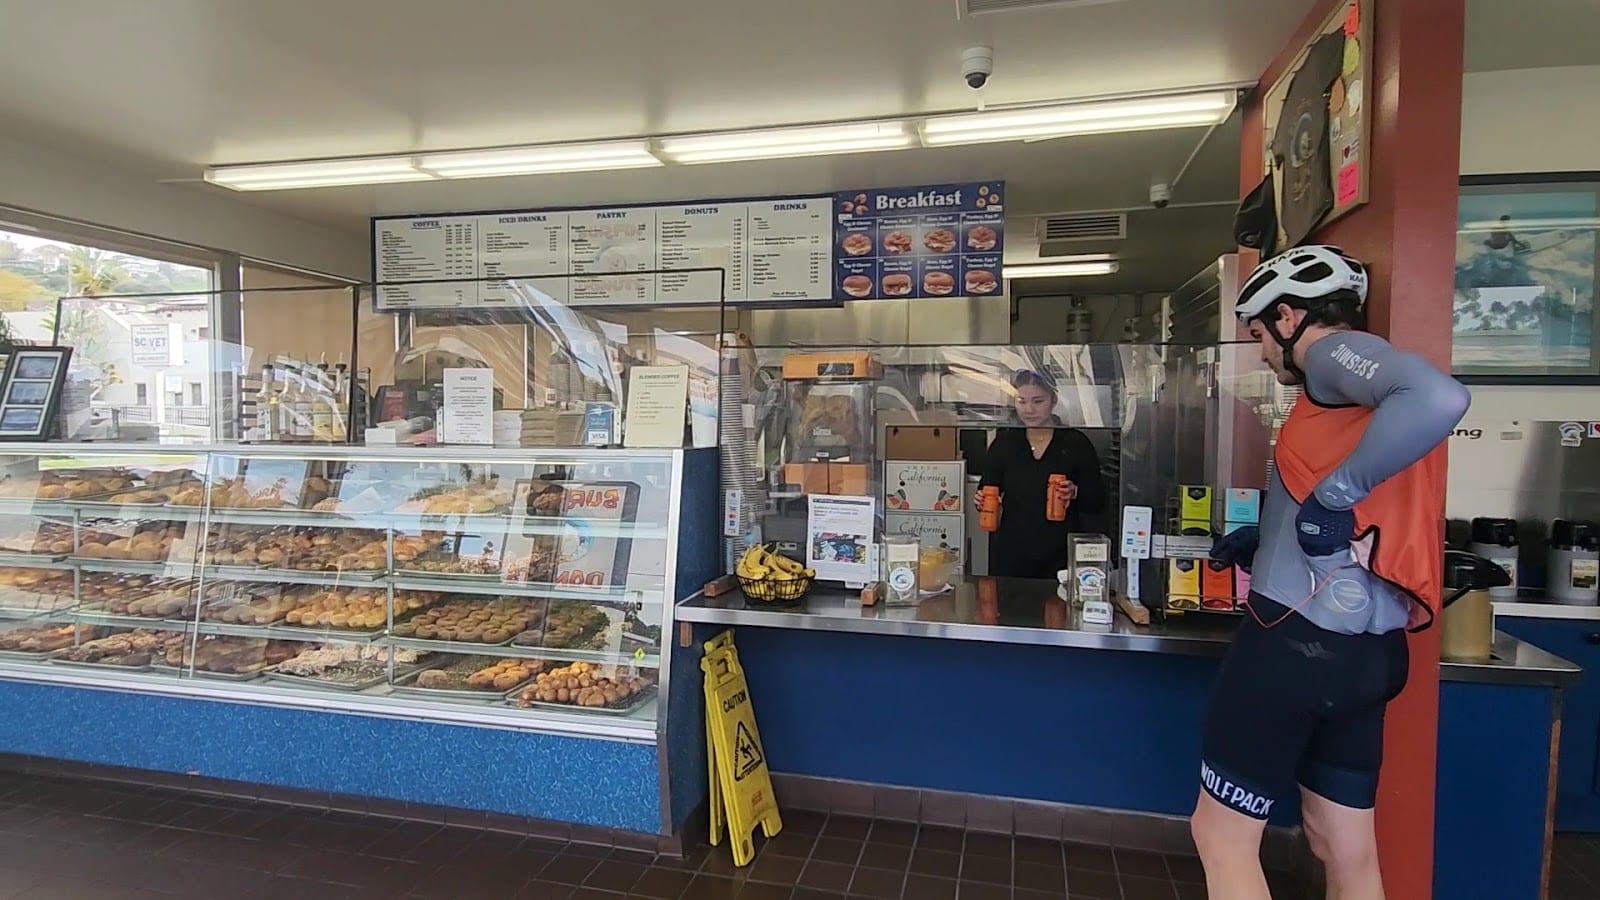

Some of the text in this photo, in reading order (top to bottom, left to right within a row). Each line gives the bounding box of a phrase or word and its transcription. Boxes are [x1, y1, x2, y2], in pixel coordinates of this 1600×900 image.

[774, 203, 807, 211] DRINKS
[876, 190, 962, 210] Breakfast
[684, 207, 719, 215] DONUTS
[134, 337, 166, 347] SC VET
[899, 469, 946, 484] California
[899, 521, 947, 536] California
[723, 689, 747, 713] CAUTION
